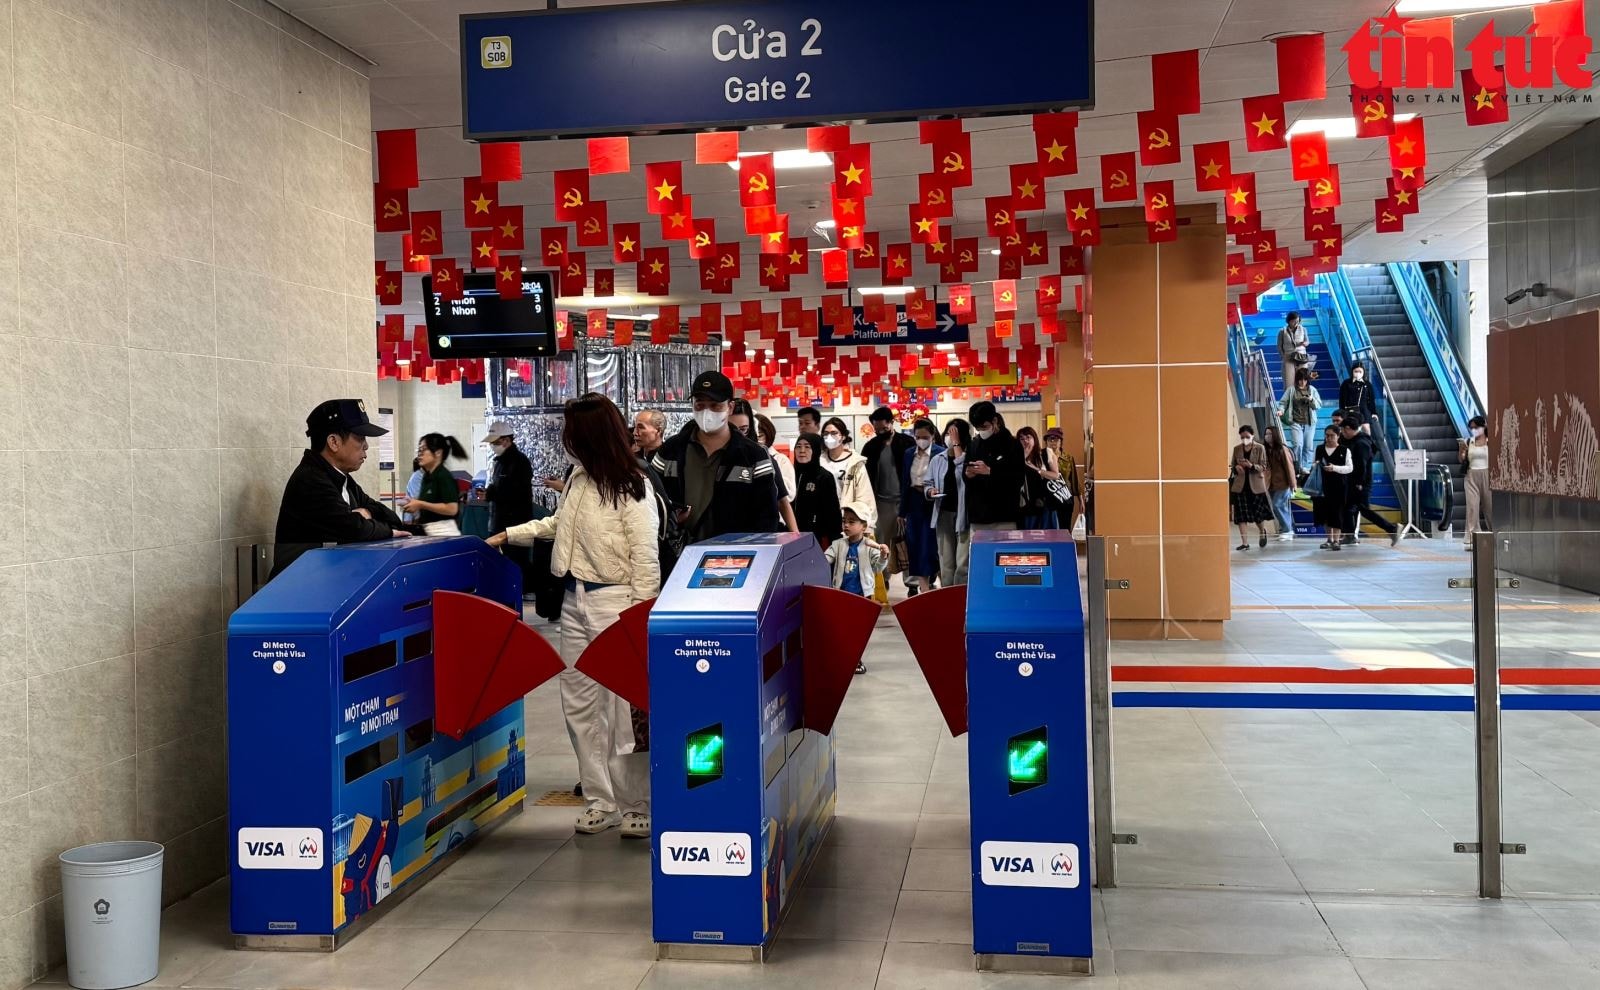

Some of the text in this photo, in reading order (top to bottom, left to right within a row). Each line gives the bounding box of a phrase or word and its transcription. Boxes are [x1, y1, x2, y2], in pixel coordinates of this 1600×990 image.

[491, 41, 501, 50] T3
[712, 18, 822, 61] Cửa 2
[487, 52, 506, 62] S08
[725, 72, 812, 103] Gate 2
[434, 297, 440, 306] 2
[534, 294, 541, 303] 3
[435, 304, 541, 316] 2 Nhon 9
[853, 330, 892, 339] Platform
[1018, 642, 1044, 650] Metro
[253, 651, 275, 660] Chạm
[674, 649, 698, 657] Chạm
[995, 652, 1020, 660] Chạm
[344, 696, 380, 723] MỘT CHẠM
[368, 714, 382, 732] MỌI
[381, 706, 399, 726] TRẠM
[244, 841, 285, 856] VISA
[667, 846, 710, 862] VISA
[988, 856, 1035, 873] VISA
